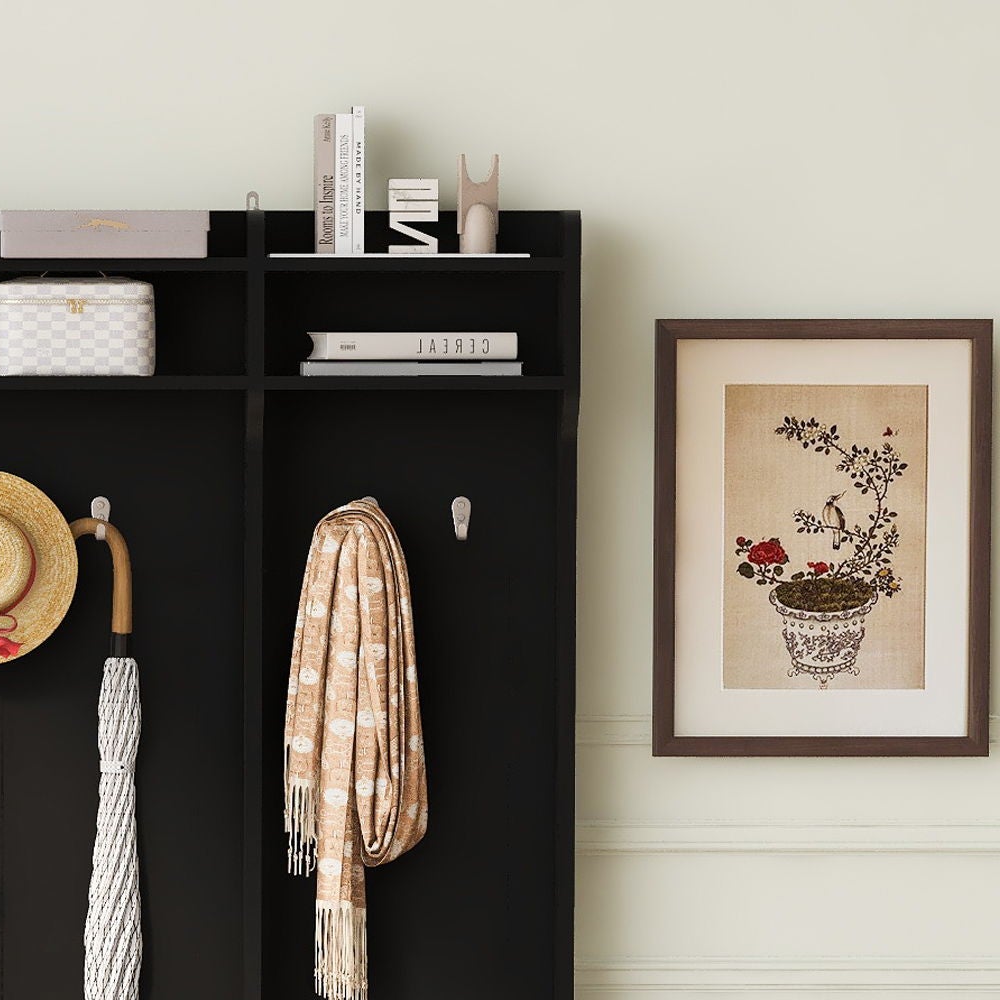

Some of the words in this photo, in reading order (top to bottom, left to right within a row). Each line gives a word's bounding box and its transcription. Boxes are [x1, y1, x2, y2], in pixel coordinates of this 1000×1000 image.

[340, 134, 349, 160] FRIENDS
[340, 160, 349, 182] AMONG
[355, 172, 362, 184] BY
[318, 174, 334, 204] Inspire
[340, 184, 349, 202] HOME
[320, 205, 334, 215] to
[340, 203, 349, 220] YOUR
[319, 216, 334, 245] Rooms
[340, 221, 349, 237] MAKE
